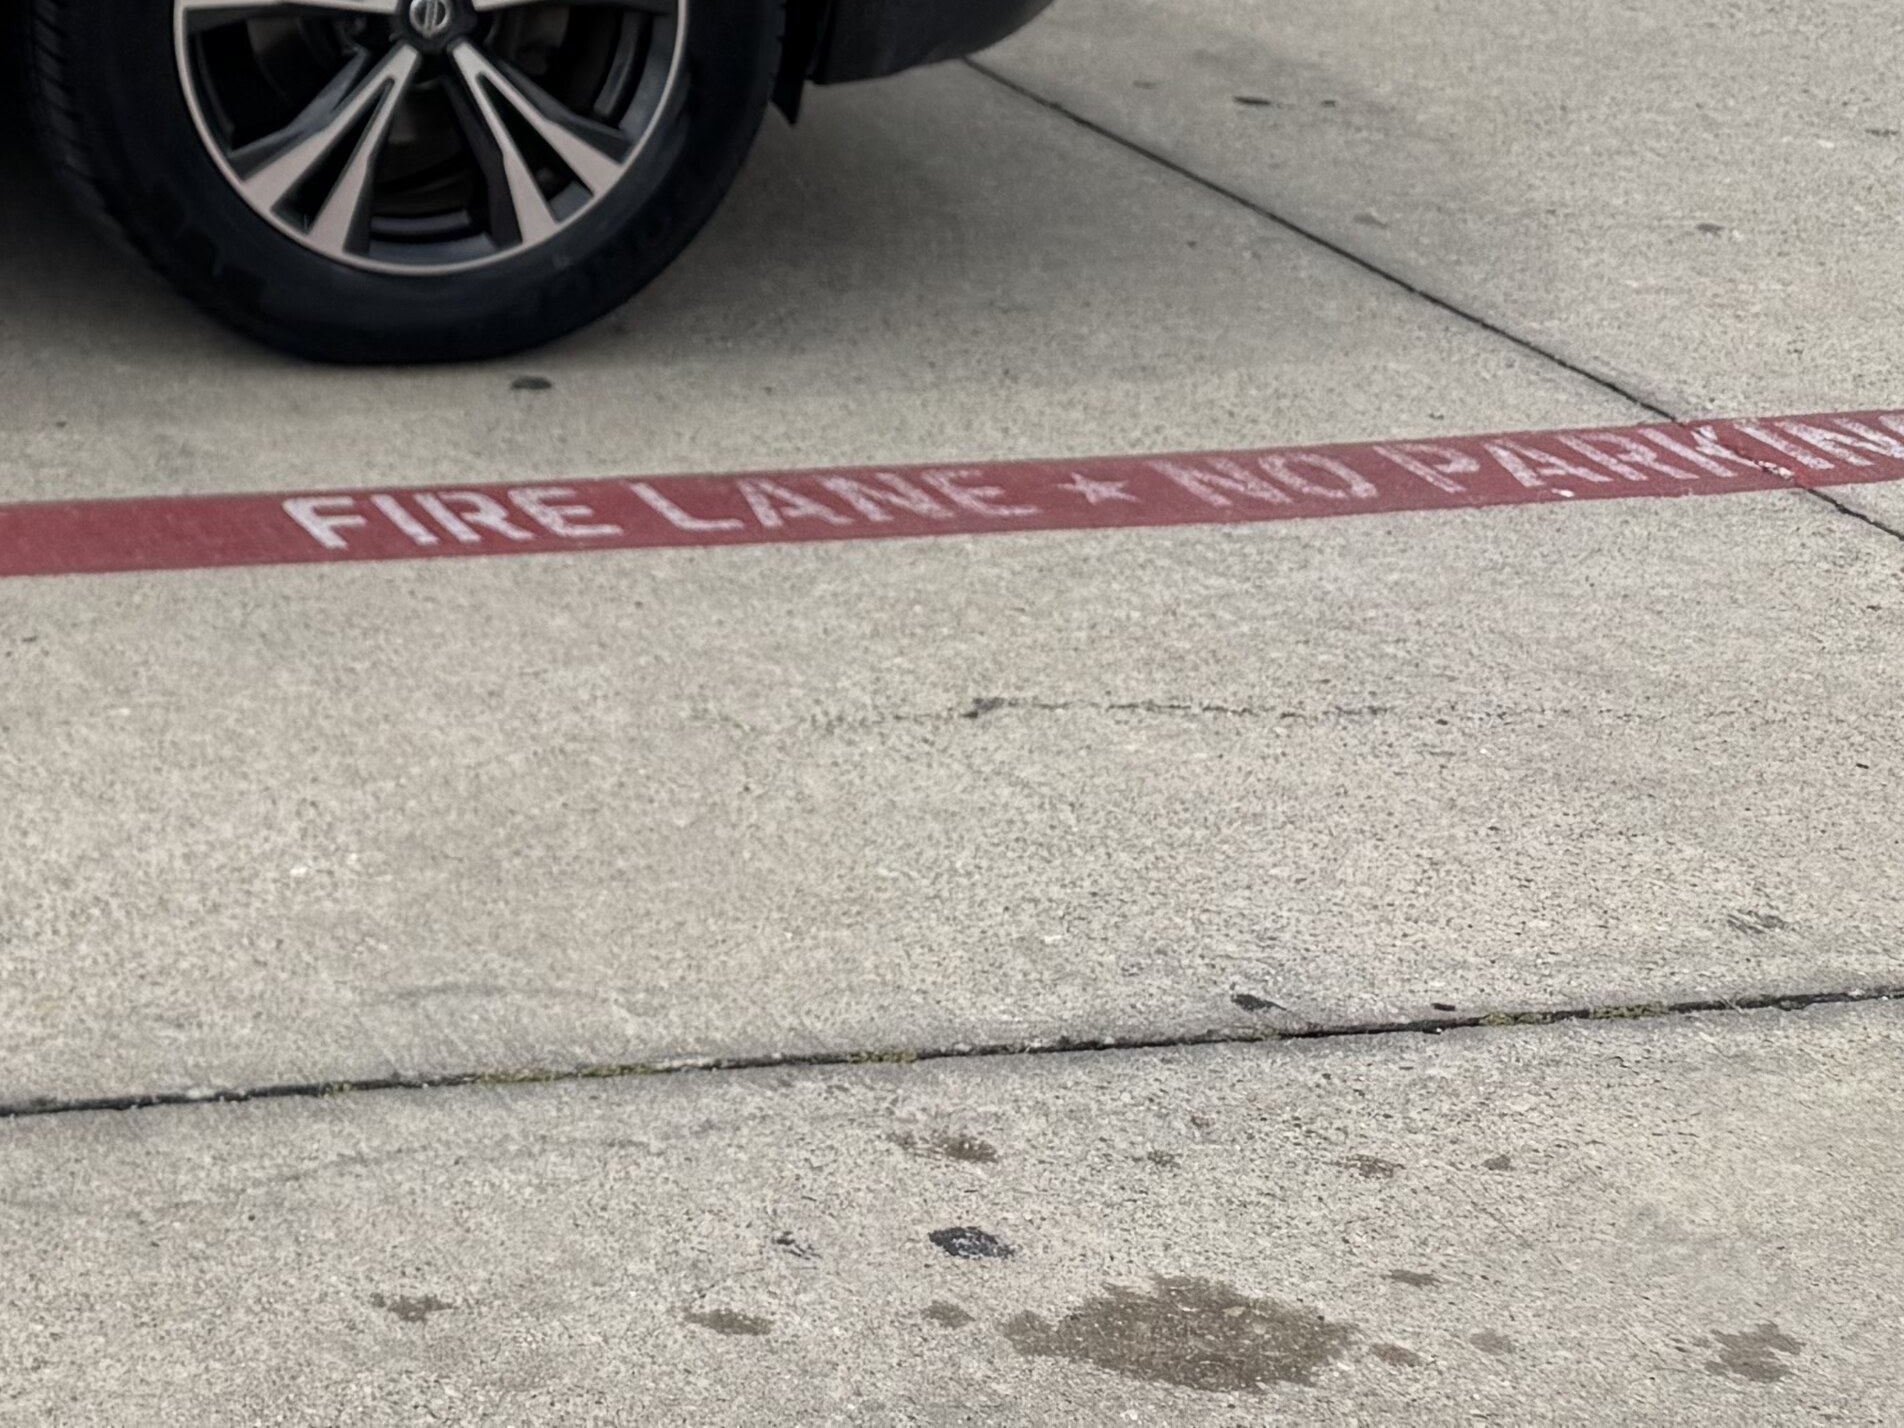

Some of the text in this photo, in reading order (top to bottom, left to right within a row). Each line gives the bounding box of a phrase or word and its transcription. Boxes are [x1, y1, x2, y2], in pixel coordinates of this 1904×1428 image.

[280, 485, 624, 550] FIRE
[627, 467, 1039, 532] LANE
[1150, 451, 1380, 507] NO
